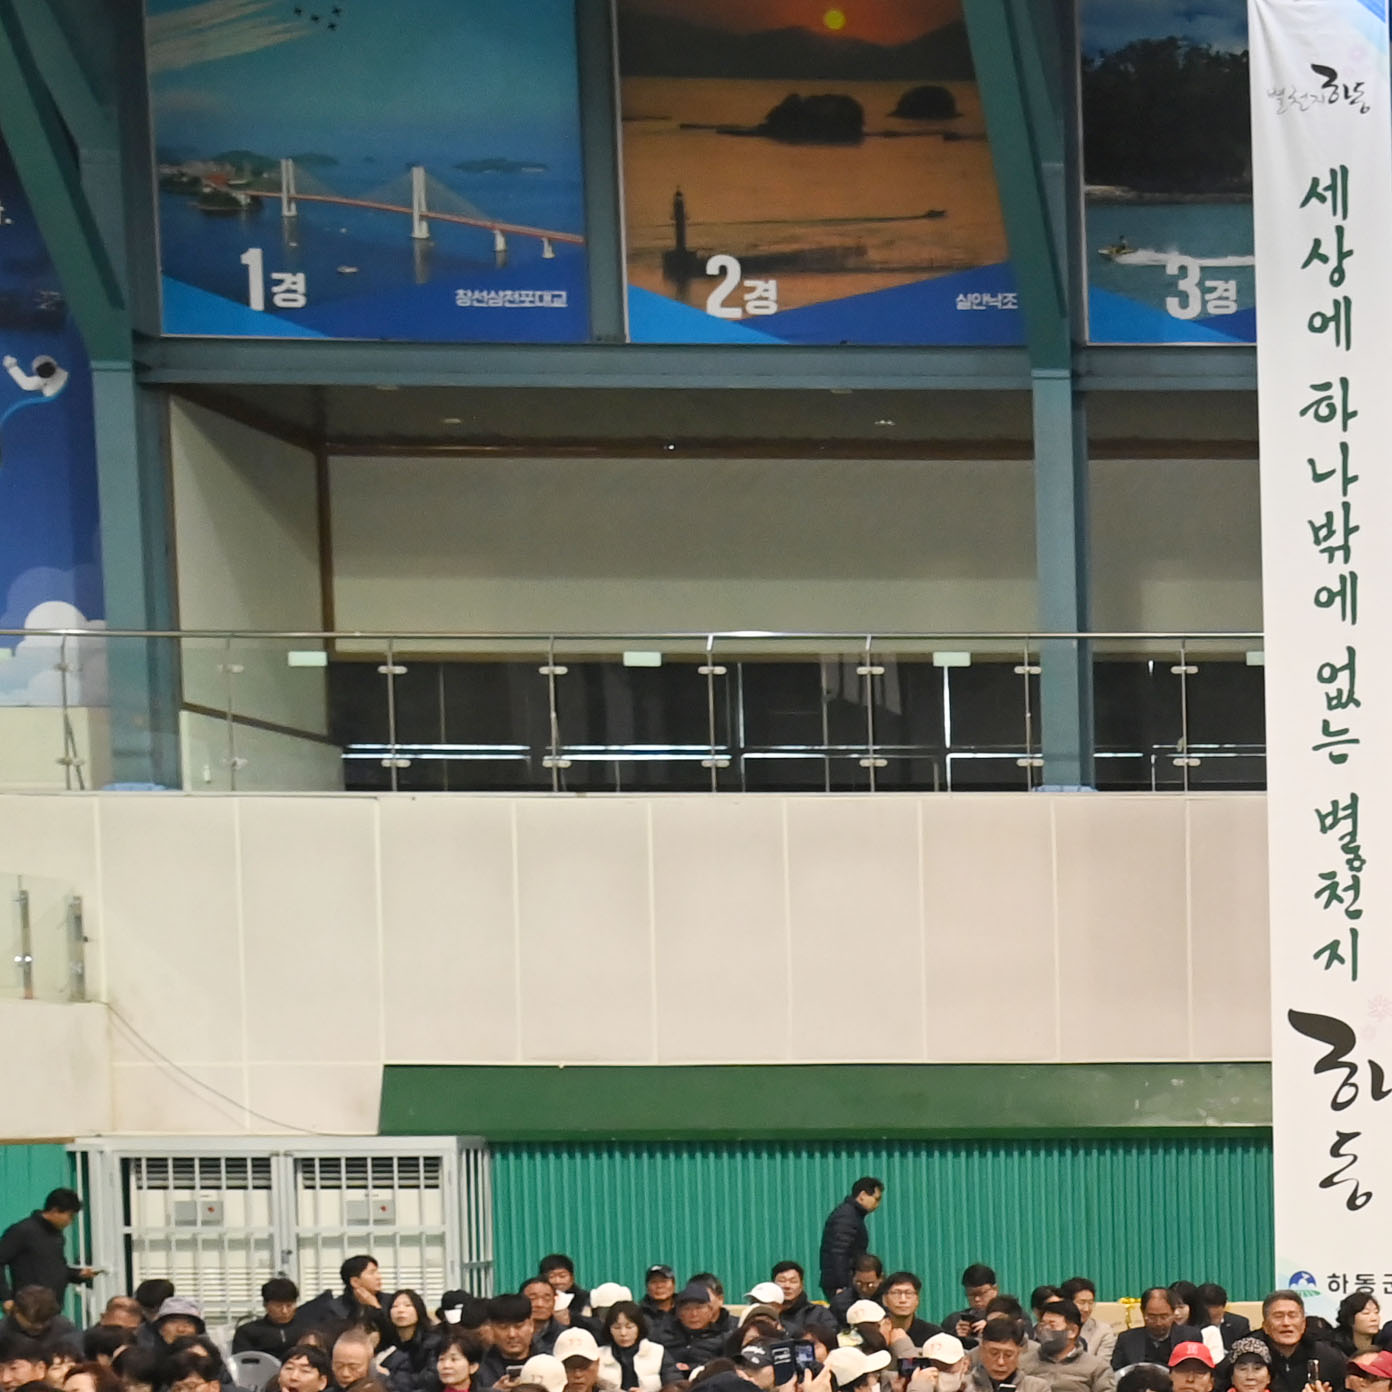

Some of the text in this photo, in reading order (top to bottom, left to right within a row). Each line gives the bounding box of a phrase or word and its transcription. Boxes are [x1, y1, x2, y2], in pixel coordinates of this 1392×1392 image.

[240, 248, 307, 311] 1경
[454, 288, 568, 307] 창선삼천포대교
[705, 254, 779, 319] 2경
[955, 291, 1019, 311] 실안낙조
[1165, 256, 1238, 320] 3경
[1299, 164, 1367, 982] 세상에 하나밖에 없는 별천지
